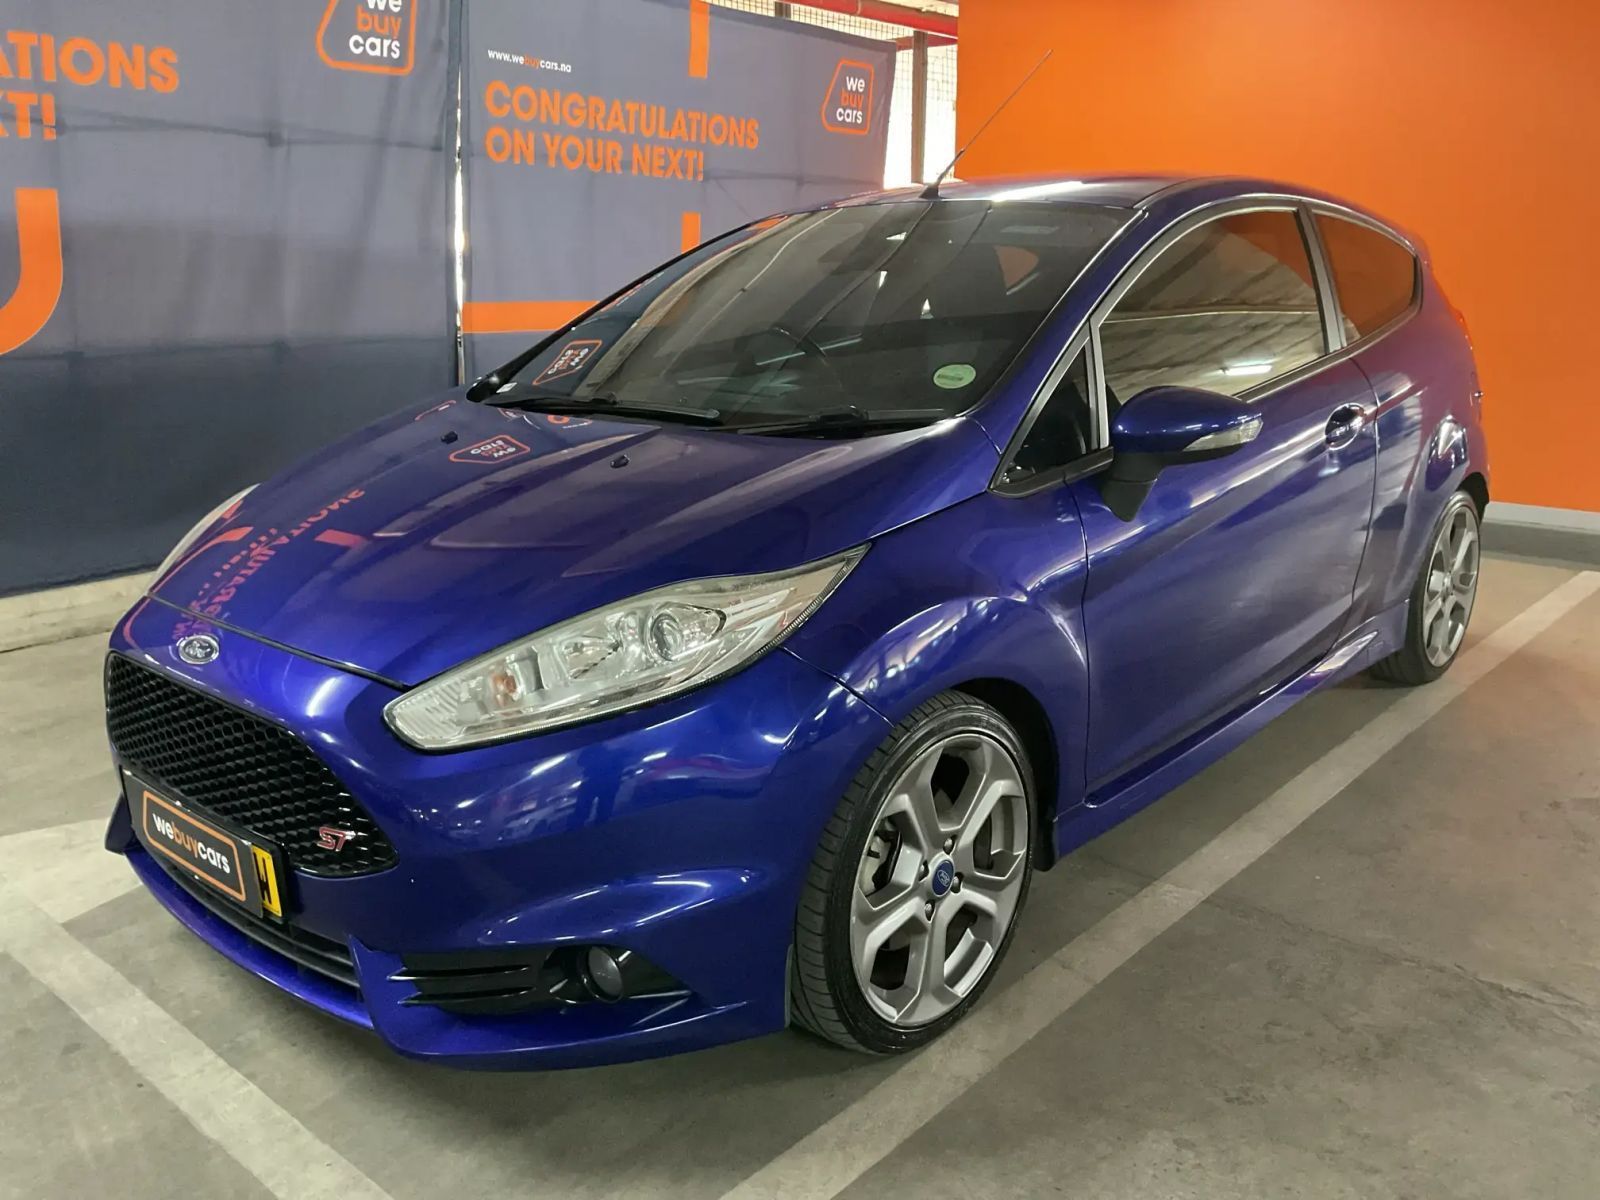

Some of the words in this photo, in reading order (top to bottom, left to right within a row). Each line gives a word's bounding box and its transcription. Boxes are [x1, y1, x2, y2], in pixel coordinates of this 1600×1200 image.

[356, 4, 402, 39] buy
[348, 34, 401, 59] cars
[487, 48, 572, 73] www.webuycars.na
[846, 76, 865, 92] we
[841, 87, 864, 109] buy
[0, 90, 56, 140] T!
[485, 80, 760, 150] CONGRATULATIONS
[836, 107, 863, 124] cars
[485, 126, 535, 165] ON
[542, 131, 623, 175] YOUR
[631, 143, 704, 181] NEXT!
[152, 812, 231, 874] webuycars
[316, 826, 356, 852] ST
